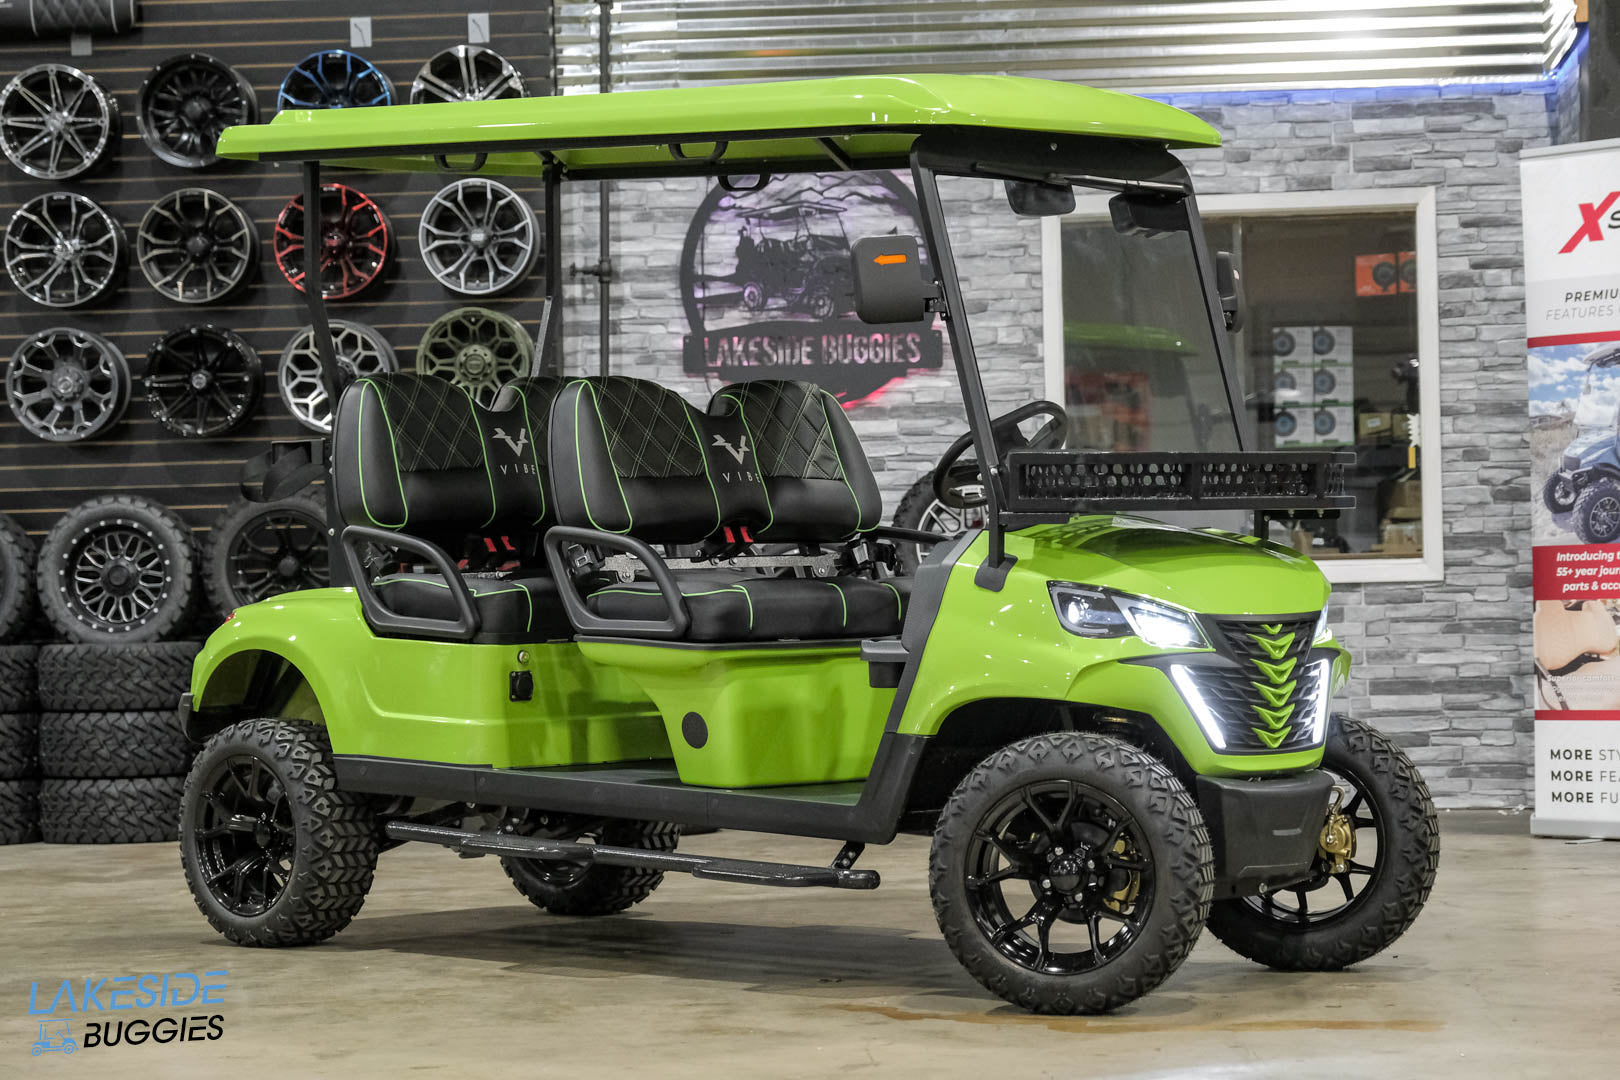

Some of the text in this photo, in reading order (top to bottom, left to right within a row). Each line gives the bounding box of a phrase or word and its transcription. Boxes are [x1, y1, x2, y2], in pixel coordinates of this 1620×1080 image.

[1546, 305, 1614, 320] FEATURES
[704, 333, 921, 367] LAKESIDE BUGGIES
[500, 463, 536, 475] VIBE
[722, 471, 760, 483] VIBE
[1556, 551, 1615, 562] Introducing
[1556, 566, 1573, 577] 55+
[1574, 567, 1598, 578] year
[1562, 582, 1589, 593] parts
[1591, 581, 1599, 591] &
[1550, 749, 1593, 760] MORE
[1551, 770, 1620, 782] MORE FE
[1552, 791, 1594, 803] MORE
